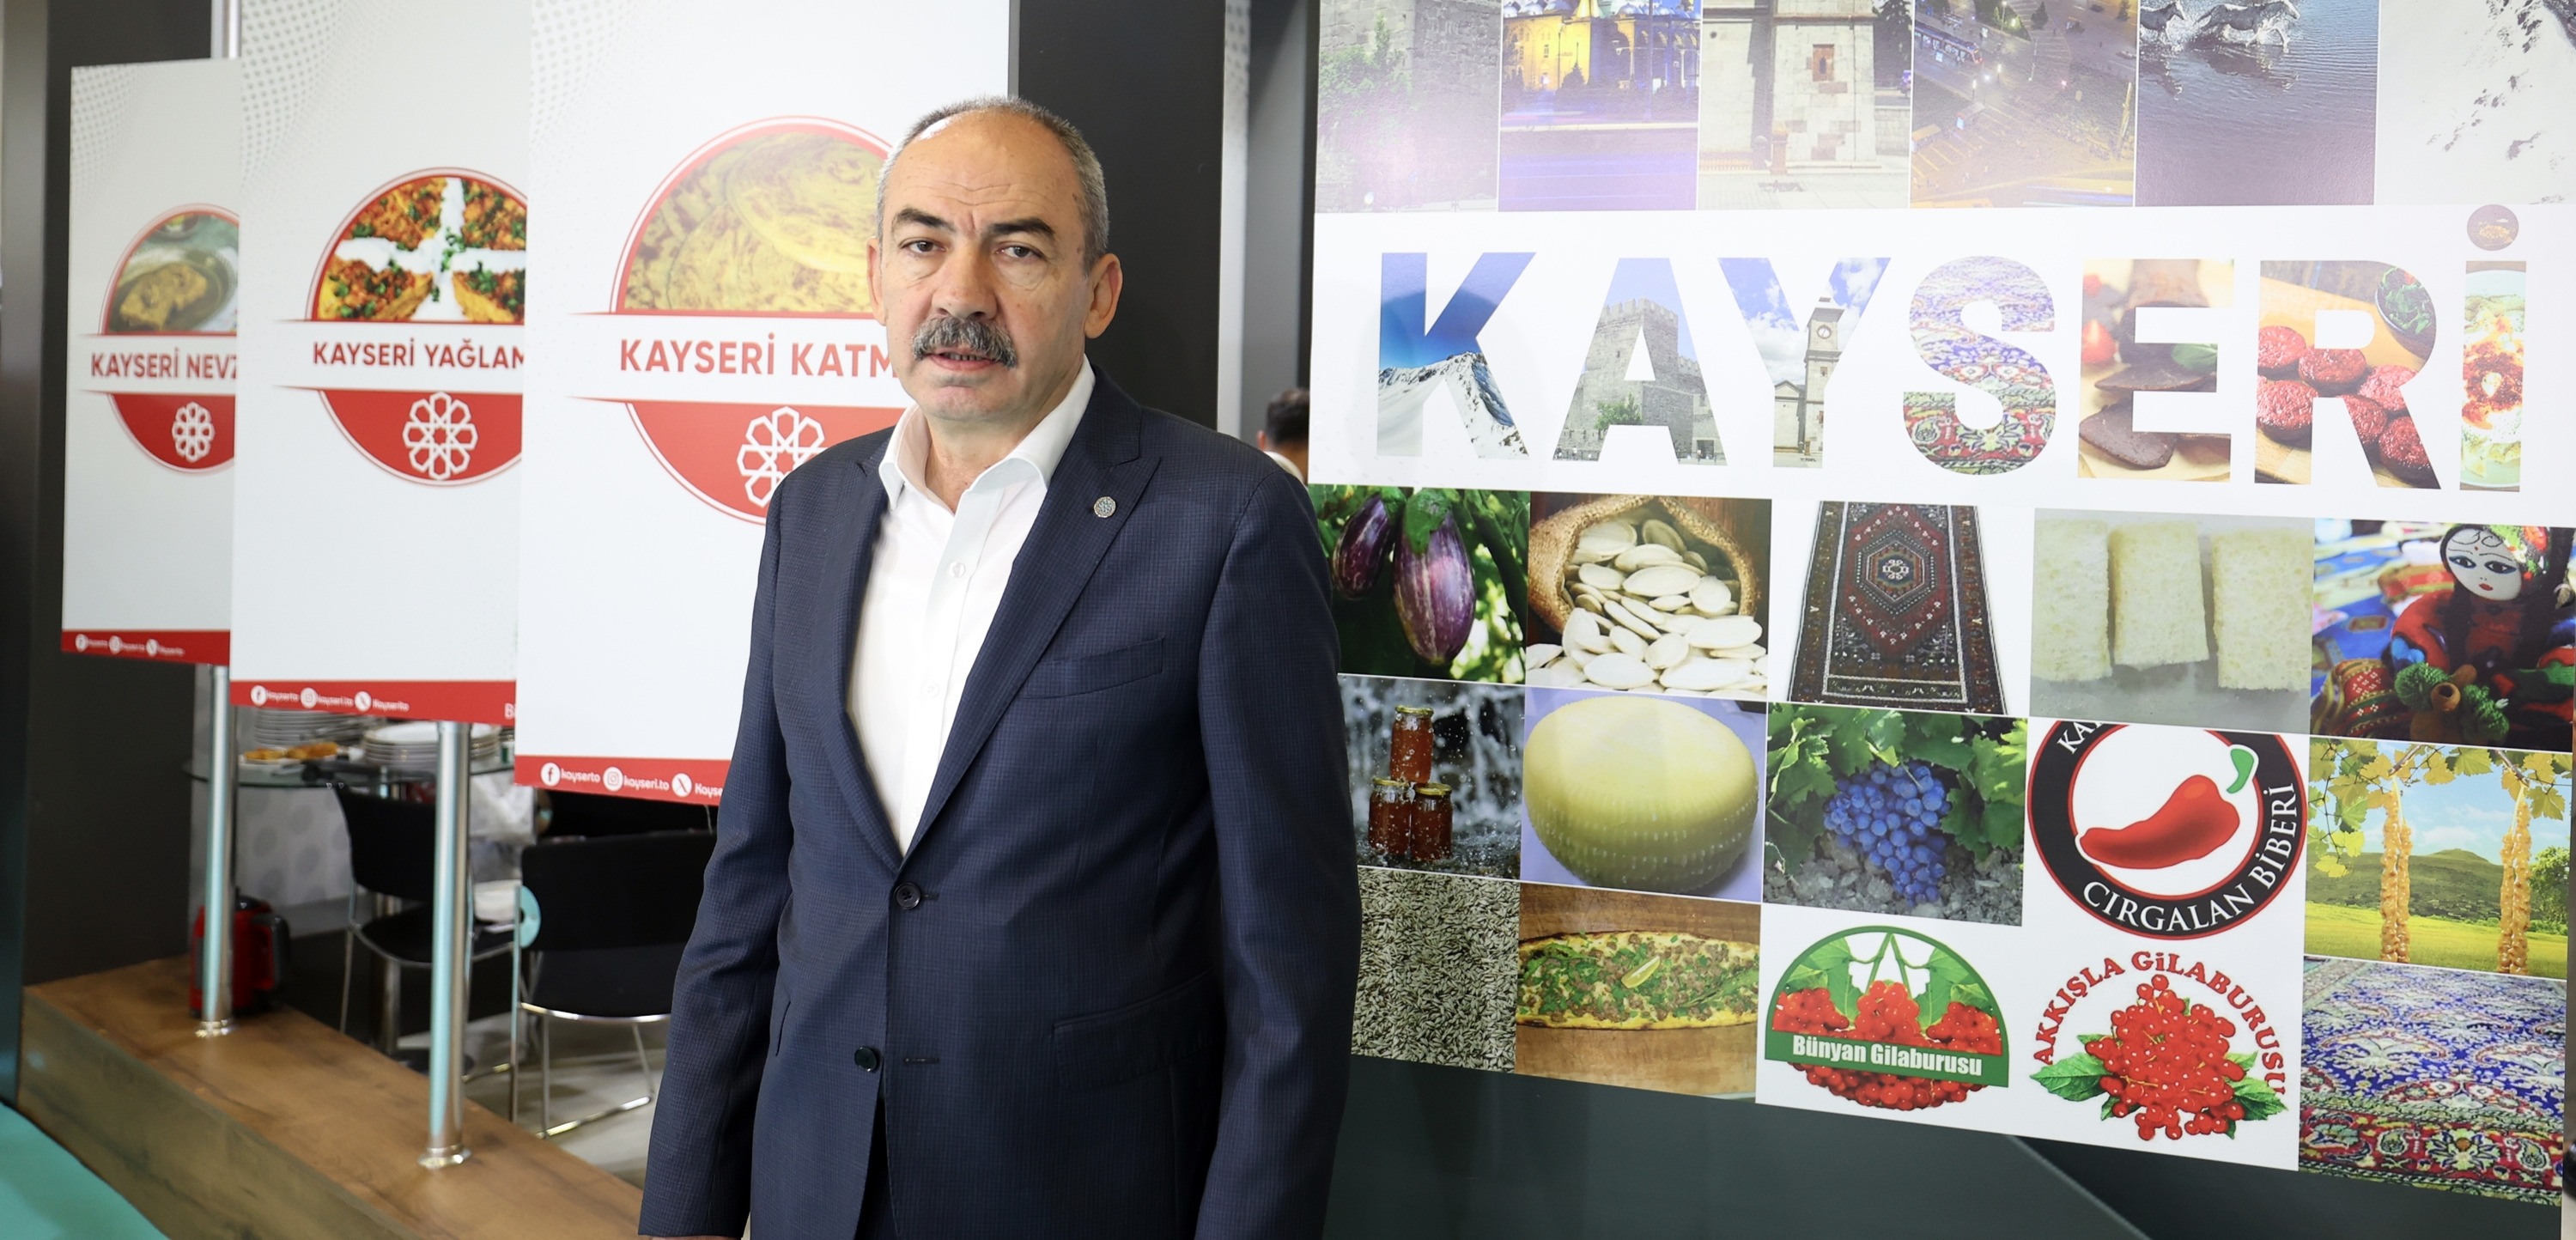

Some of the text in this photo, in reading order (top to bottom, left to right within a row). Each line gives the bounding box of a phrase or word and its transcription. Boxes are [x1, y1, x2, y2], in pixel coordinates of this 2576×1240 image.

[90, 347, 179, 380] KAYSERİ
[313, 337, 525, 369] KAYSERİ YAĞLAM
[620, 331, 899, 378] KAYSERİ KATM
[1376, 204, 2527, 493] KAYSERİ
[561, 768, 601, 783] kayserto
[623, 775, 670, 791] kayseri.to
[2082, 782, 2298, 932] CIRGALAN BİBERİ
[1793, 1034, 1983, 1077] Bünyan Gilaburusu
